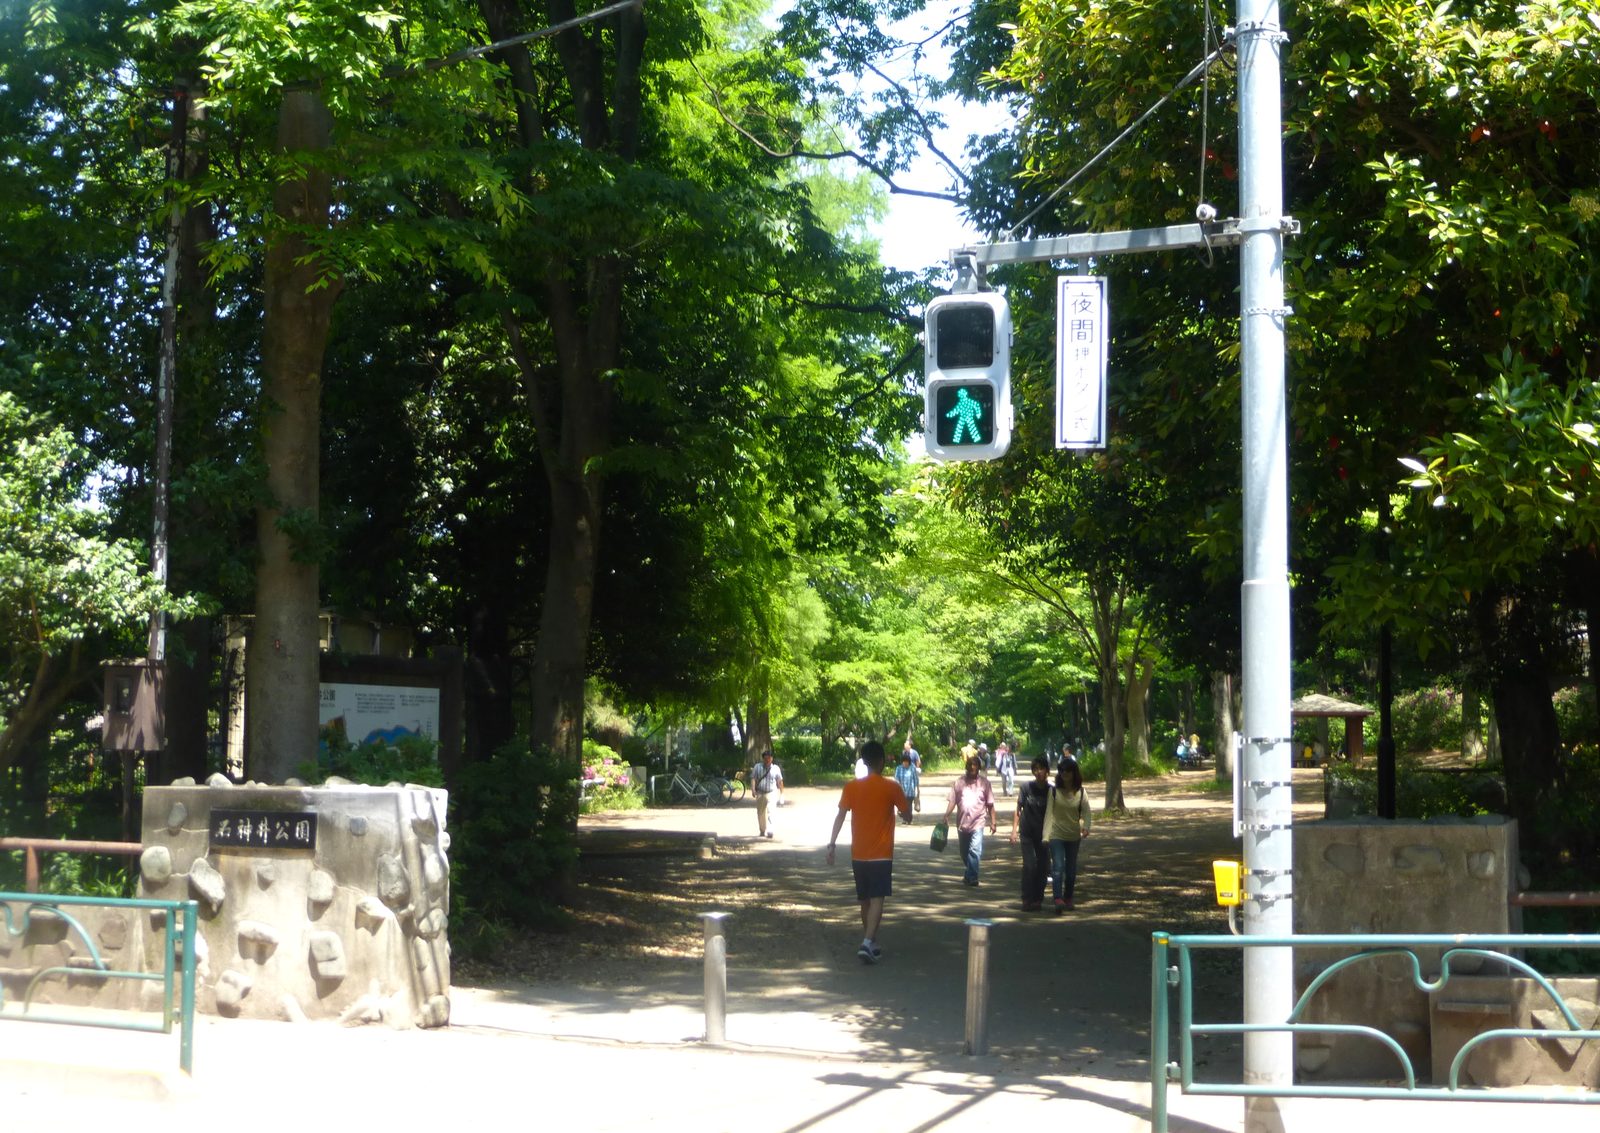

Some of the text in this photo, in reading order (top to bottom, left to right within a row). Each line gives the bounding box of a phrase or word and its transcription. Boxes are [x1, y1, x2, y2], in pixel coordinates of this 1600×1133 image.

[215, 816, 310, 843] 石神井公園
